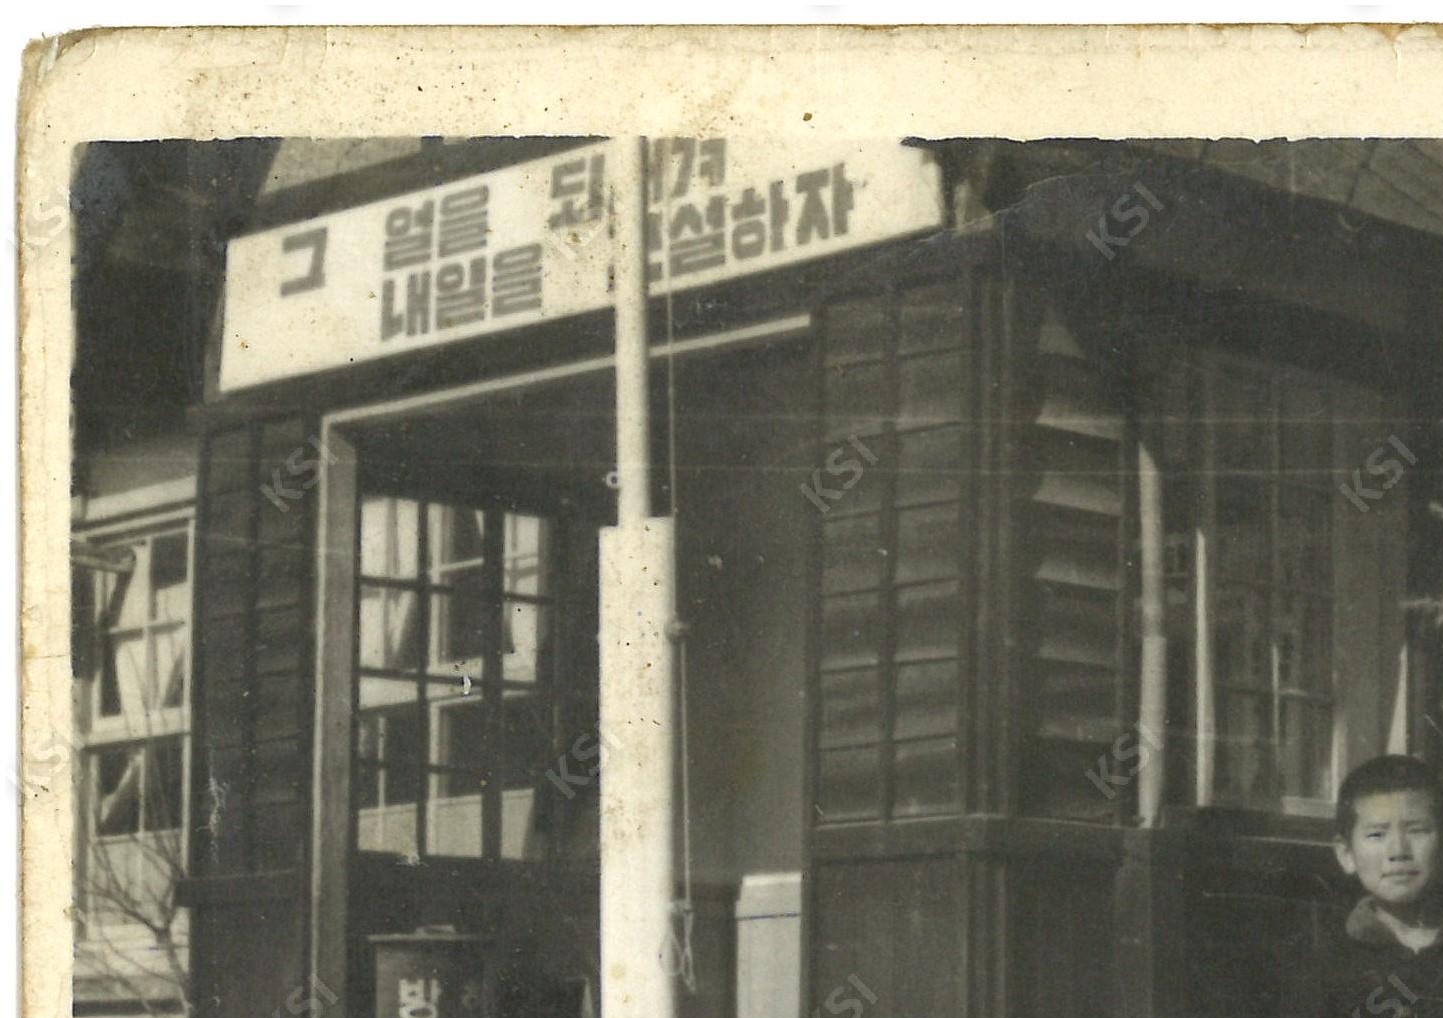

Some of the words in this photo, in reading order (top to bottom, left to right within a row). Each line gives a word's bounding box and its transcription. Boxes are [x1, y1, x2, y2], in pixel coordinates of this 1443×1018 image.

[279, 228, 328, 297] 그
[383, 186, 490, 272] 얼을
[381, 242, 544, 341] 내일을
